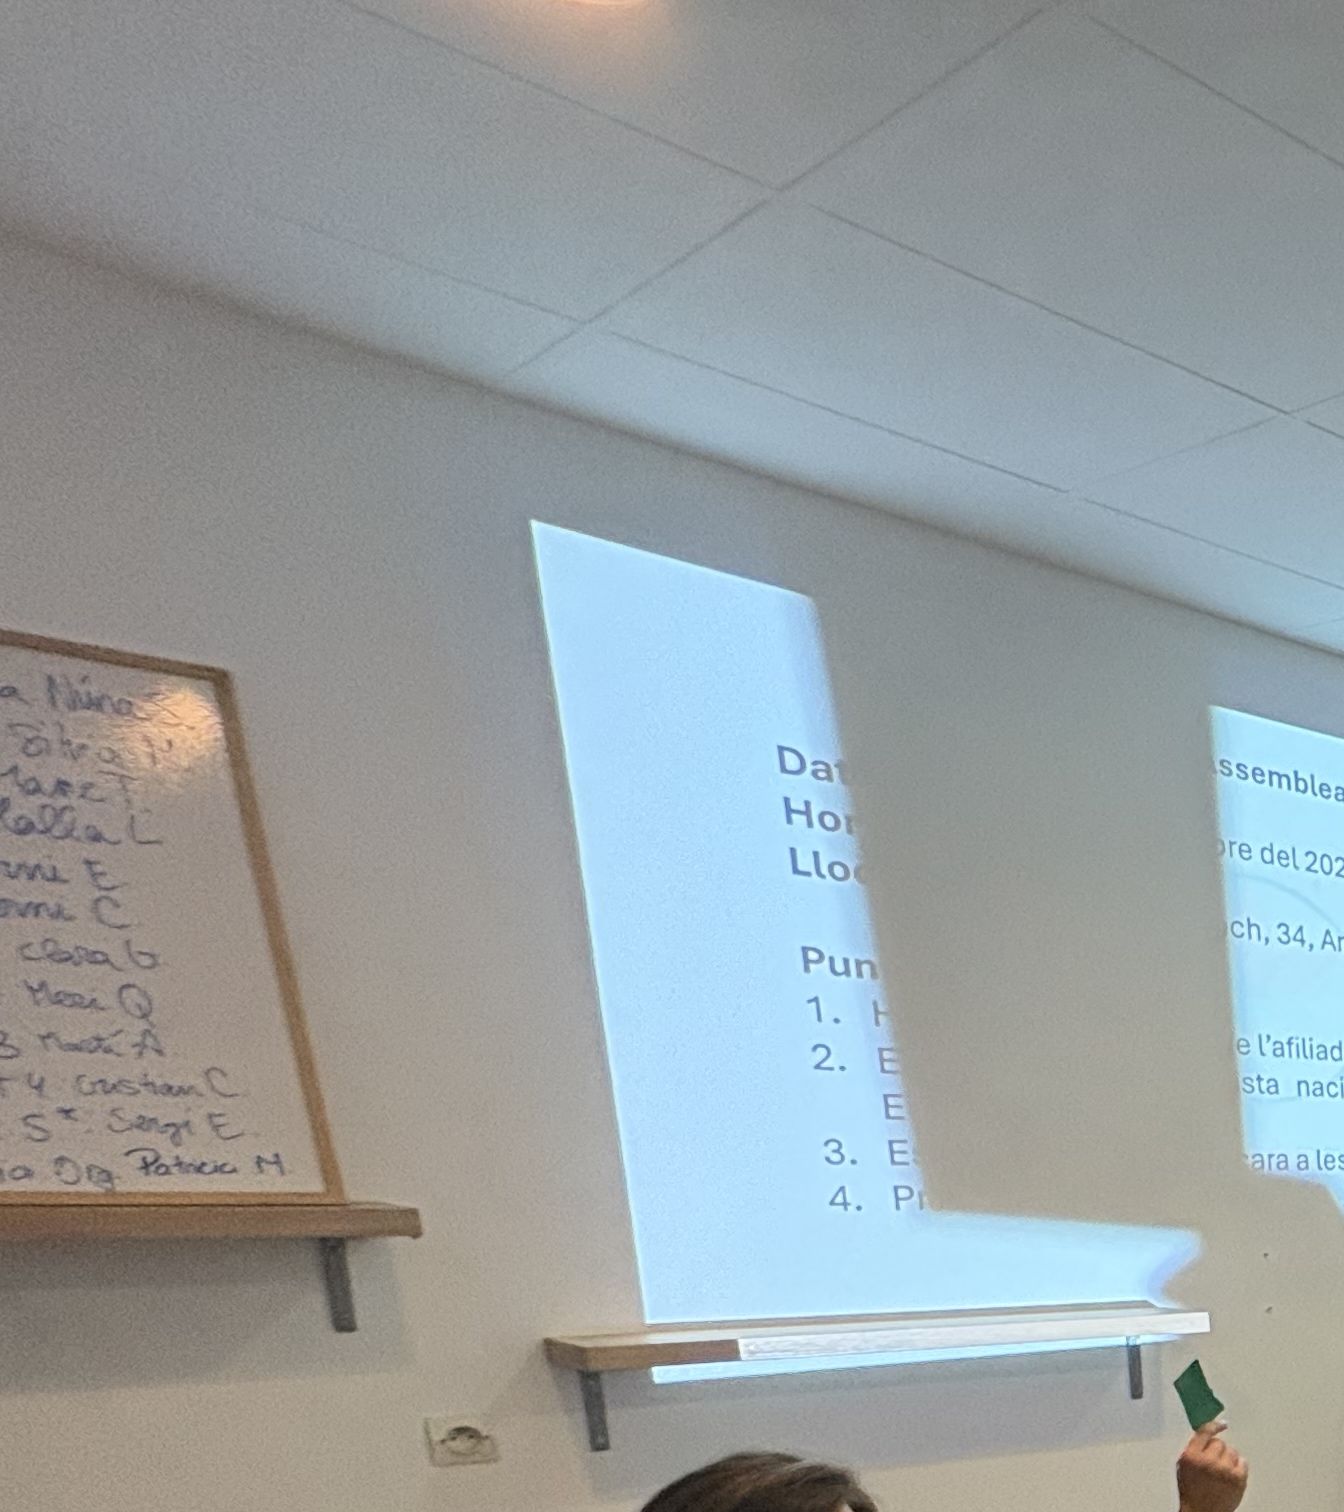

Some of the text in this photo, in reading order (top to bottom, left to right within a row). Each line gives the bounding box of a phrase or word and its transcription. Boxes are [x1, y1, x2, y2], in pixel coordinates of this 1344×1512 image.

[1260, 842, 1300, 871] del
[1276, 922, 1315, 952] 34,
[806, 996, 841, 1023] 1.
[811, 1043, 847, 1072] 2.
[823, 1138, 858, 1166] 3.
[1243, 1152, 1290, 1171] ara
[1296, 1153, 1310, 1172] a
[828, 1185, 863, 1212] 4.
